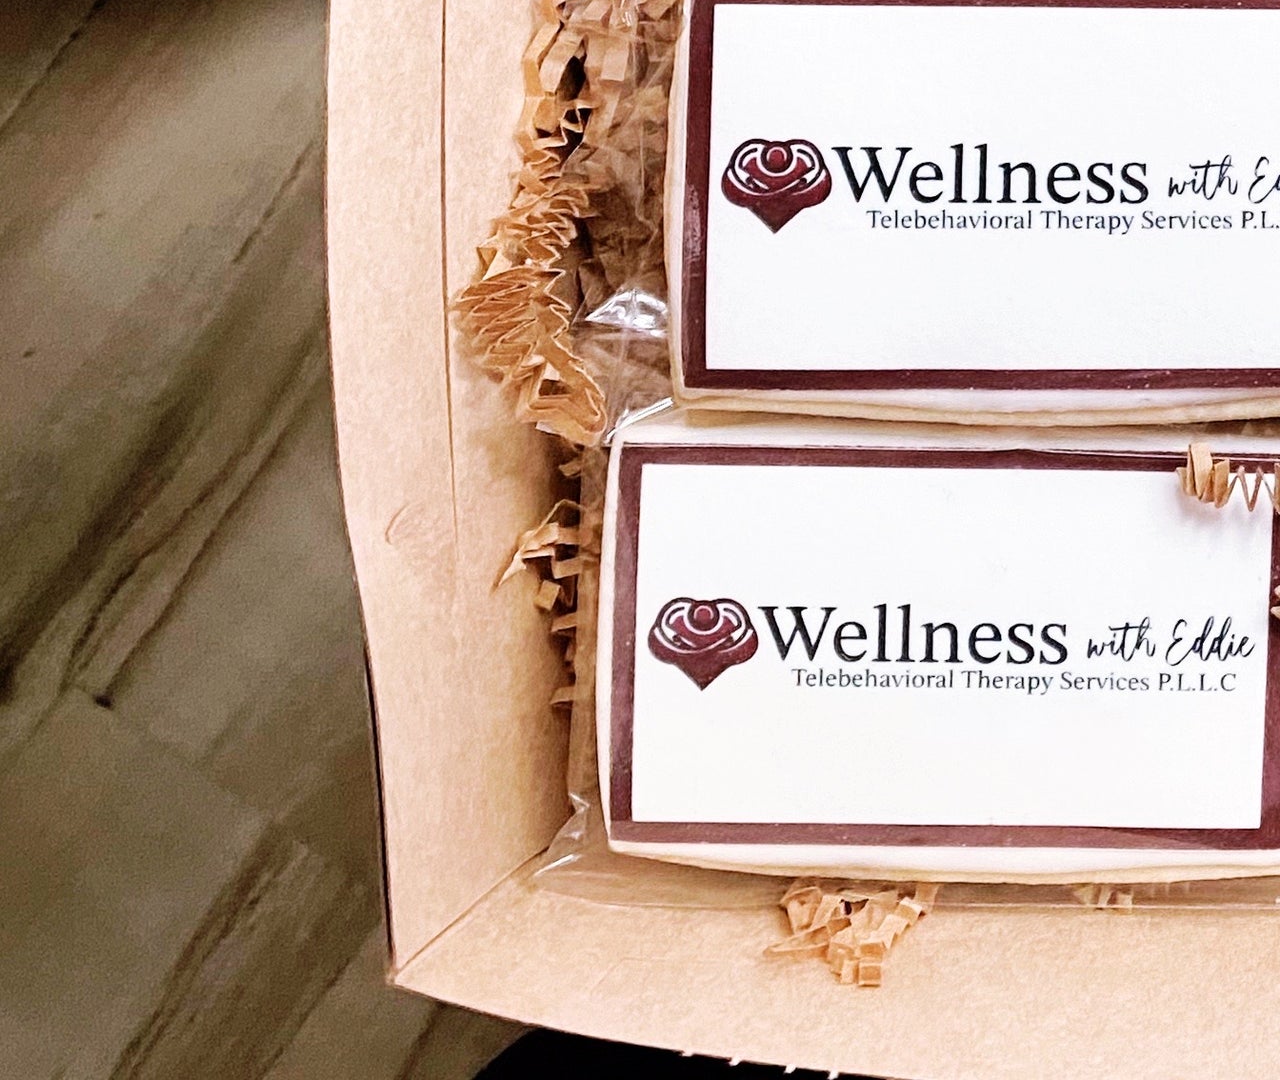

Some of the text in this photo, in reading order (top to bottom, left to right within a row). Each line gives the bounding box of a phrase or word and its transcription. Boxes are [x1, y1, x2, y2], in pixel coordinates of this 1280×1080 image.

[831, 143, 1149, 204] Wellness
[1168, 155, 1238, 200] with
[866, 209, 1031, 229] Telebehavioral
[1040, 210, 1134, 235] Therapy
[1142, 211, 1232, 229] Services
[758, 603, 1255, 666] Wellness with Eddie
[792, 668, 1236, 695] Telebehavioral Therapy Services P.L.L.C
